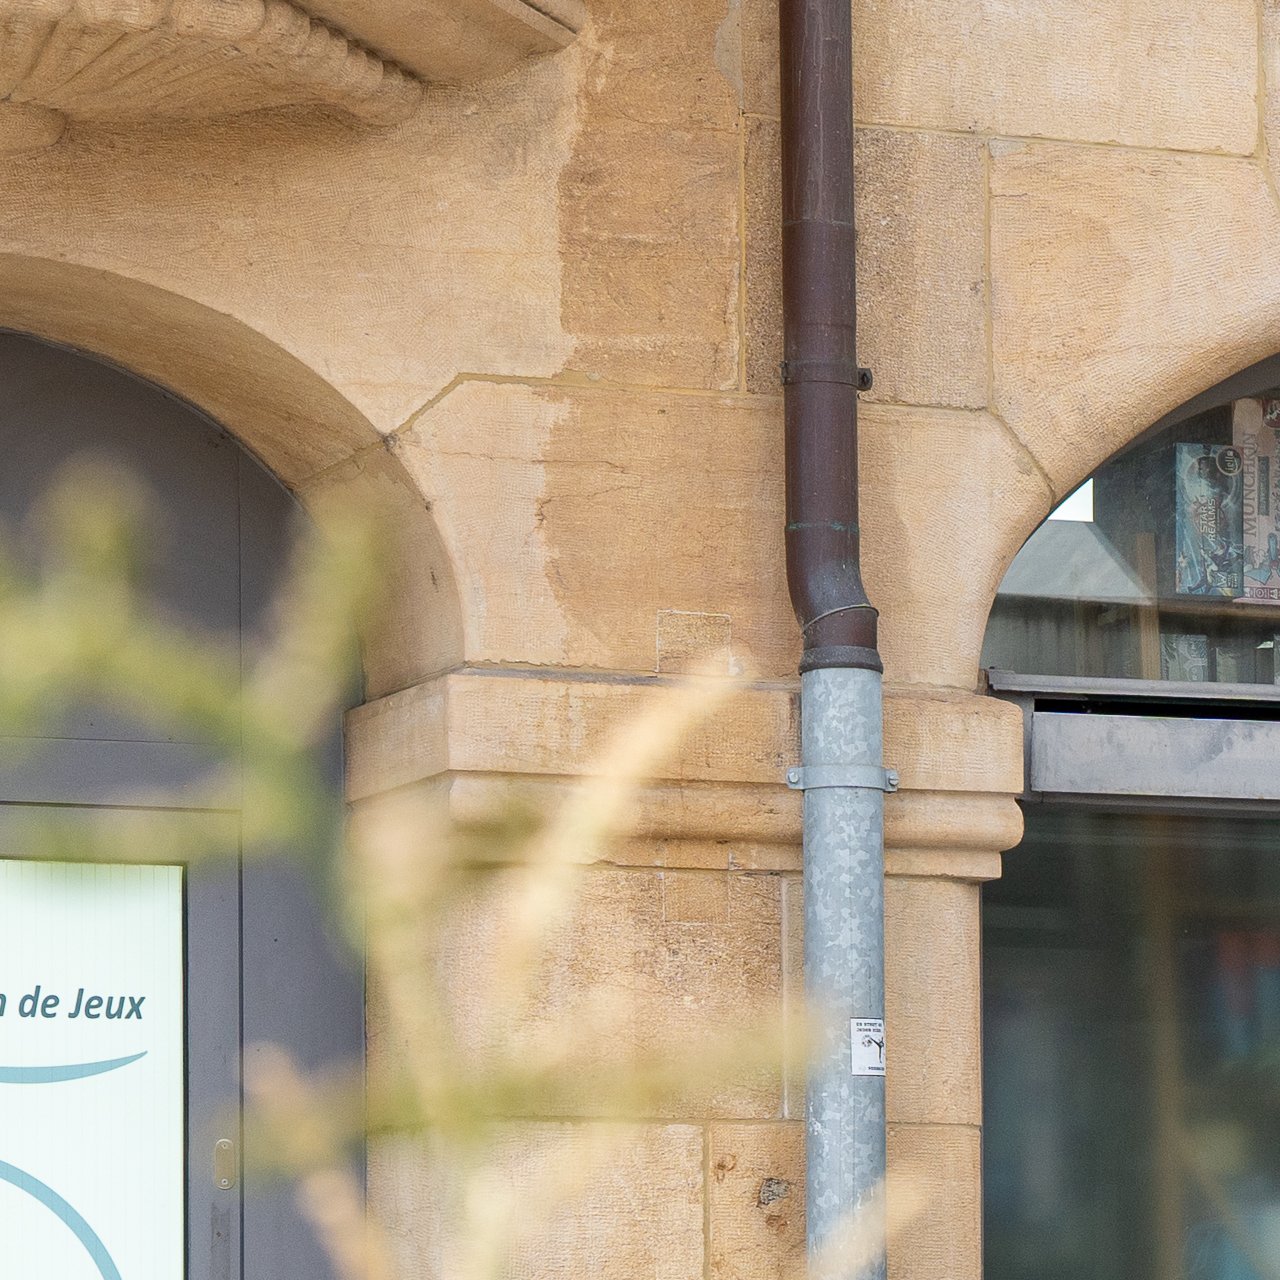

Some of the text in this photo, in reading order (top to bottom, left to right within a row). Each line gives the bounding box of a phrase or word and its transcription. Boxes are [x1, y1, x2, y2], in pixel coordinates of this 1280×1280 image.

[1243, 433, 1258, 538] MUNCHKIN
[1200, 504, 1208, 532] STAR
[1207, 497, 1216, 541] REALMS
[18, 985, 60, 1019] de
[68, 987, 146, 1020] Jeux
